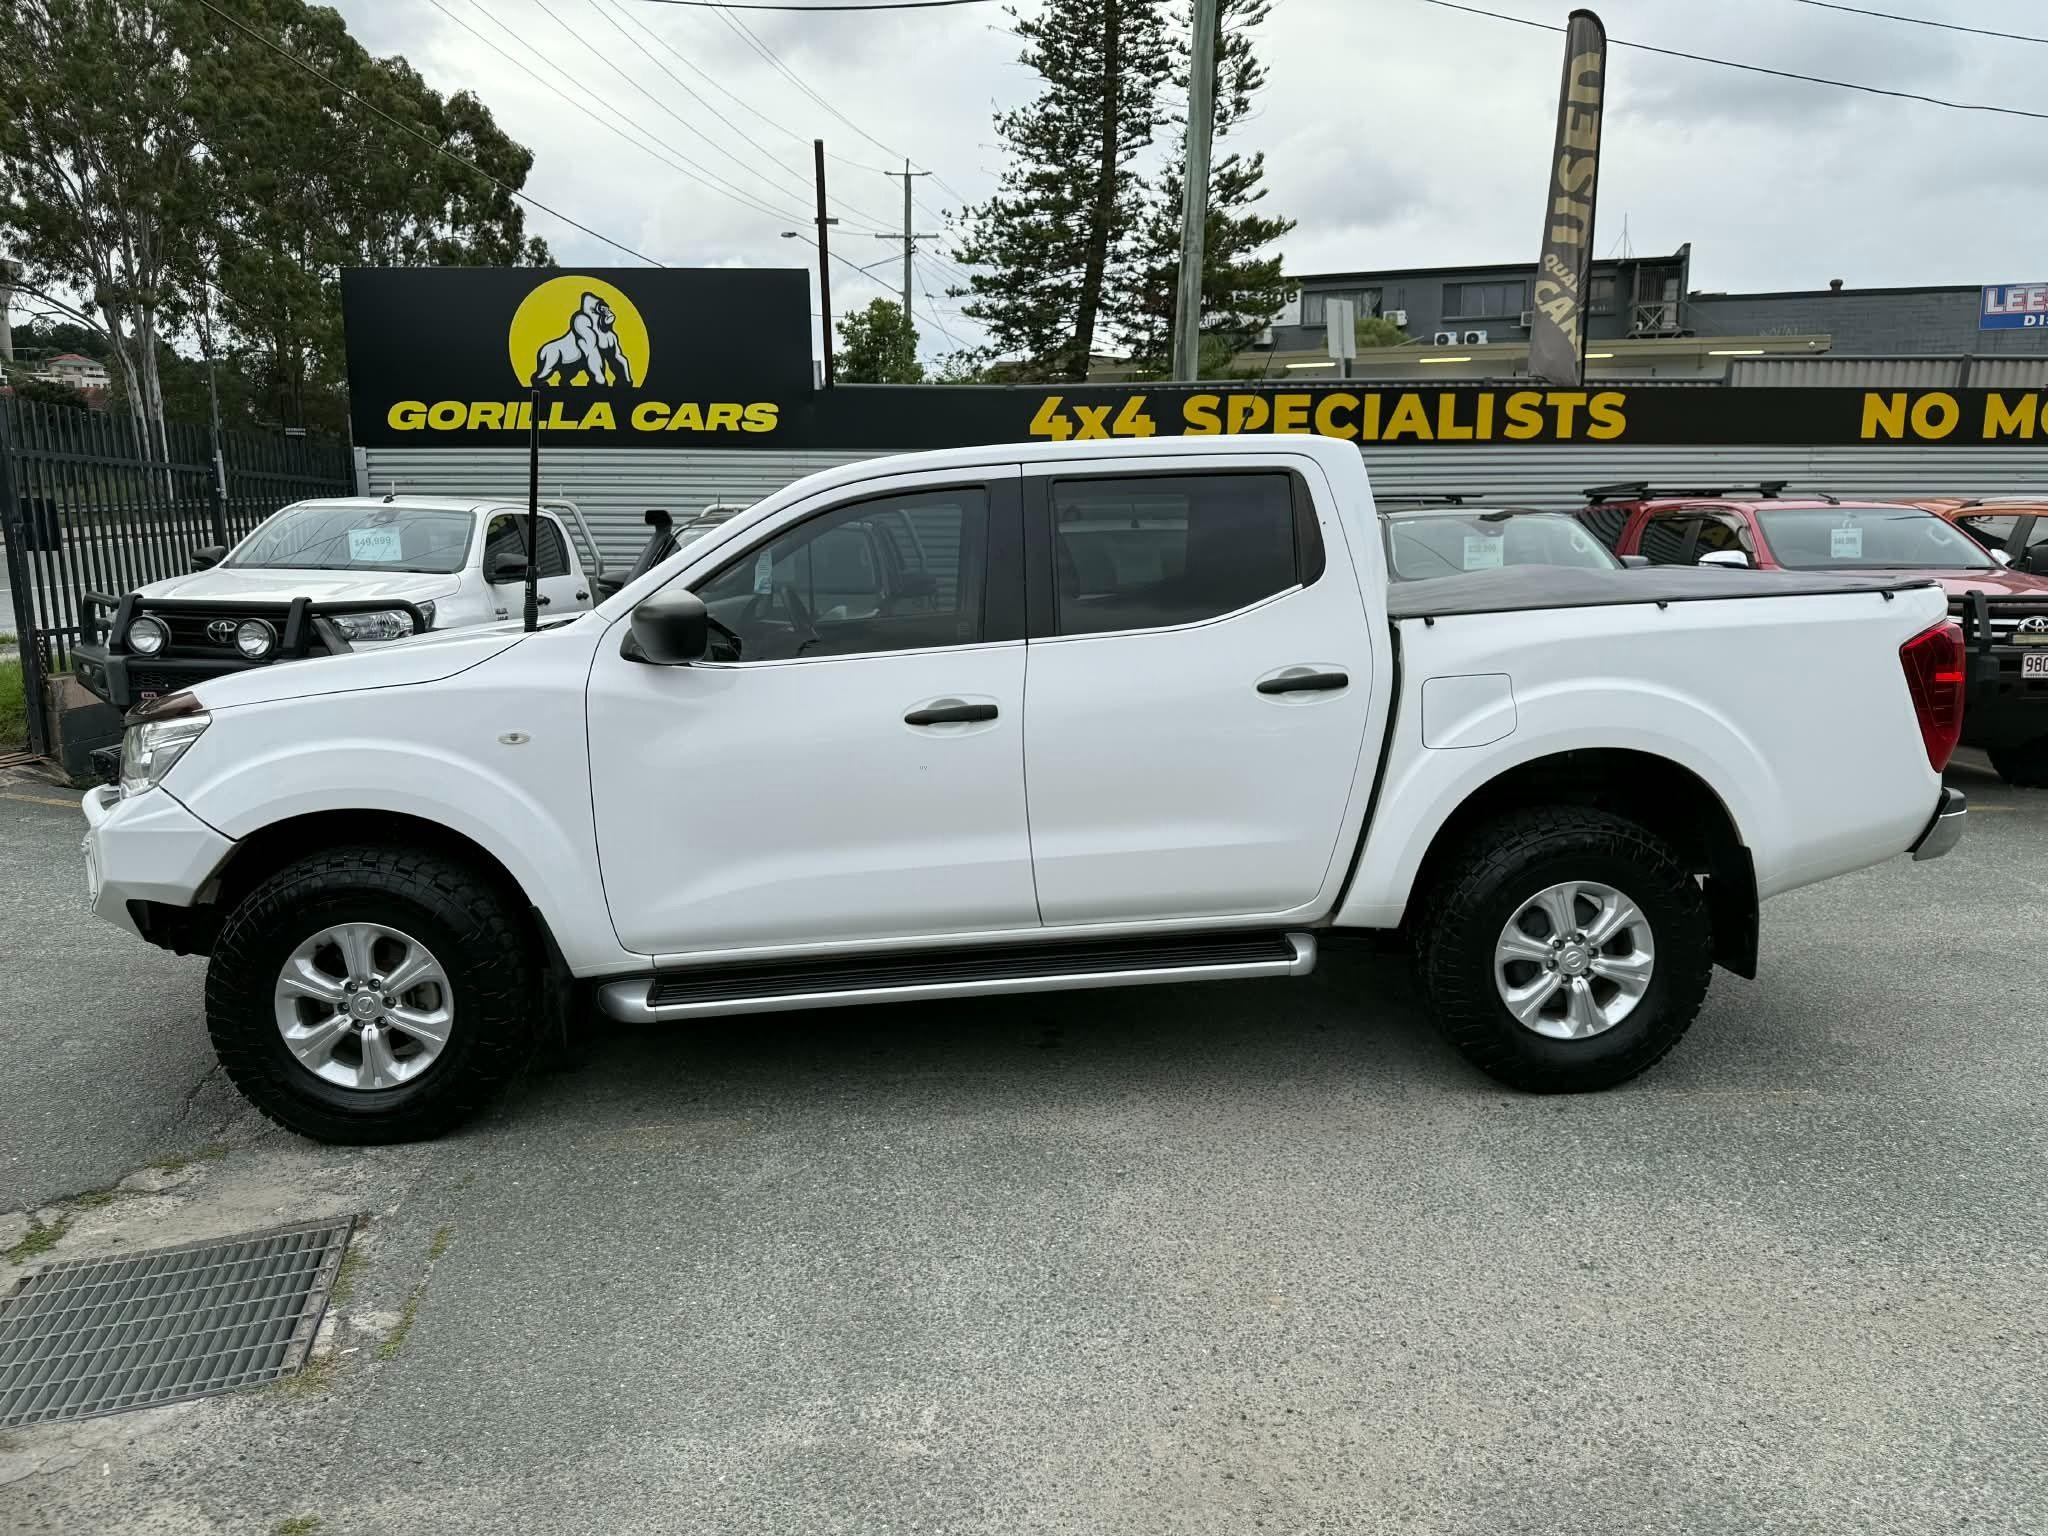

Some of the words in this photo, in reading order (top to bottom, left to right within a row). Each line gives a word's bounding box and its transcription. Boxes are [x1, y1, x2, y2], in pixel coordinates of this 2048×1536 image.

[1552, 52, 1602, 249] USED
[1985, 287, 2048, 315] LEE
[2024, 315, 2048, 326] DI
[387, 401, 616, 430] GORILLA
[631, 401, 778, 432] CARS
[1029, 395, 1156, 441] 4x4
[1183, 391, 1627, 440] SPECIALISTS
[1860, 392, 1960, 439] NO
[1983, 392, 2048, 439] M
